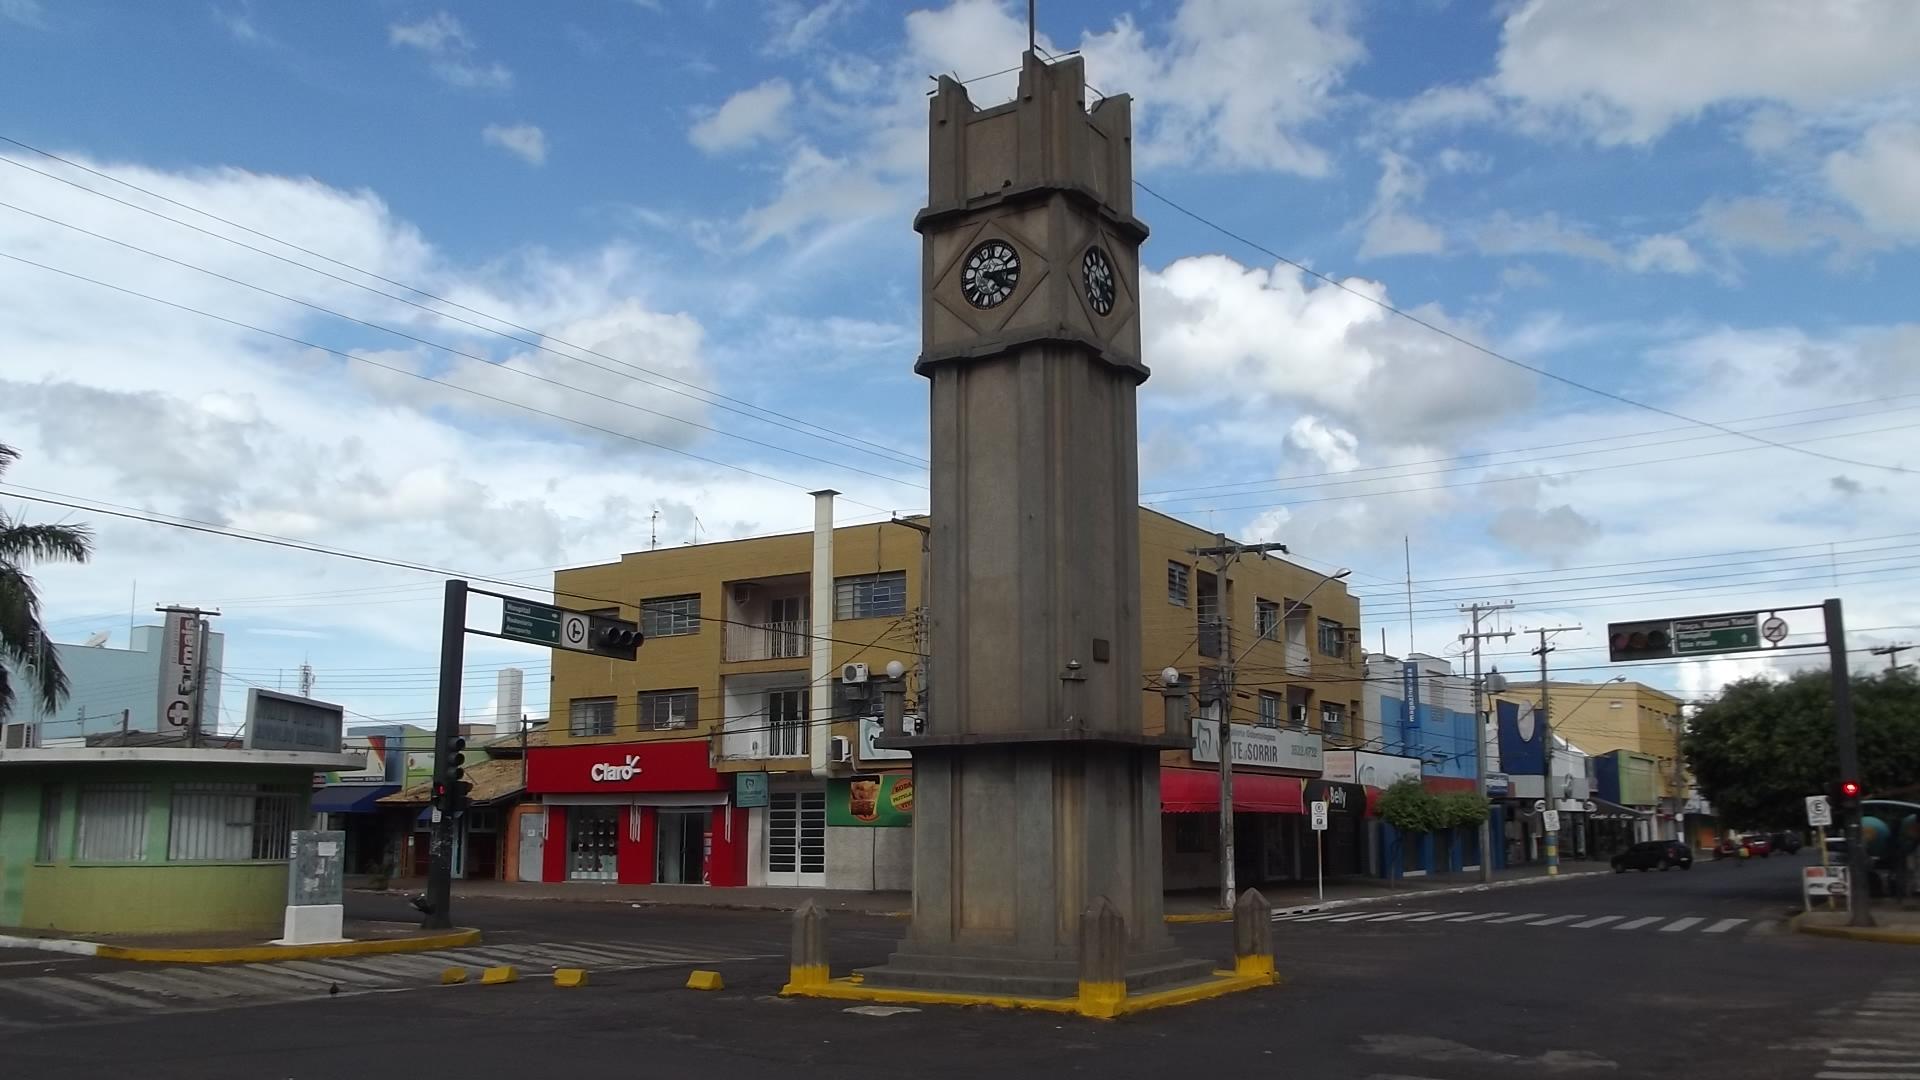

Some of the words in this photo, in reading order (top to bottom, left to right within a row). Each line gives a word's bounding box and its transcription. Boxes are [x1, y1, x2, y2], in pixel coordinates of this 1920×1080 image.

[507, 603, 531, 614] Hospital
[1247, 743, 1278, 763] SORRIR
[591, 763, 633, 782] Claro
